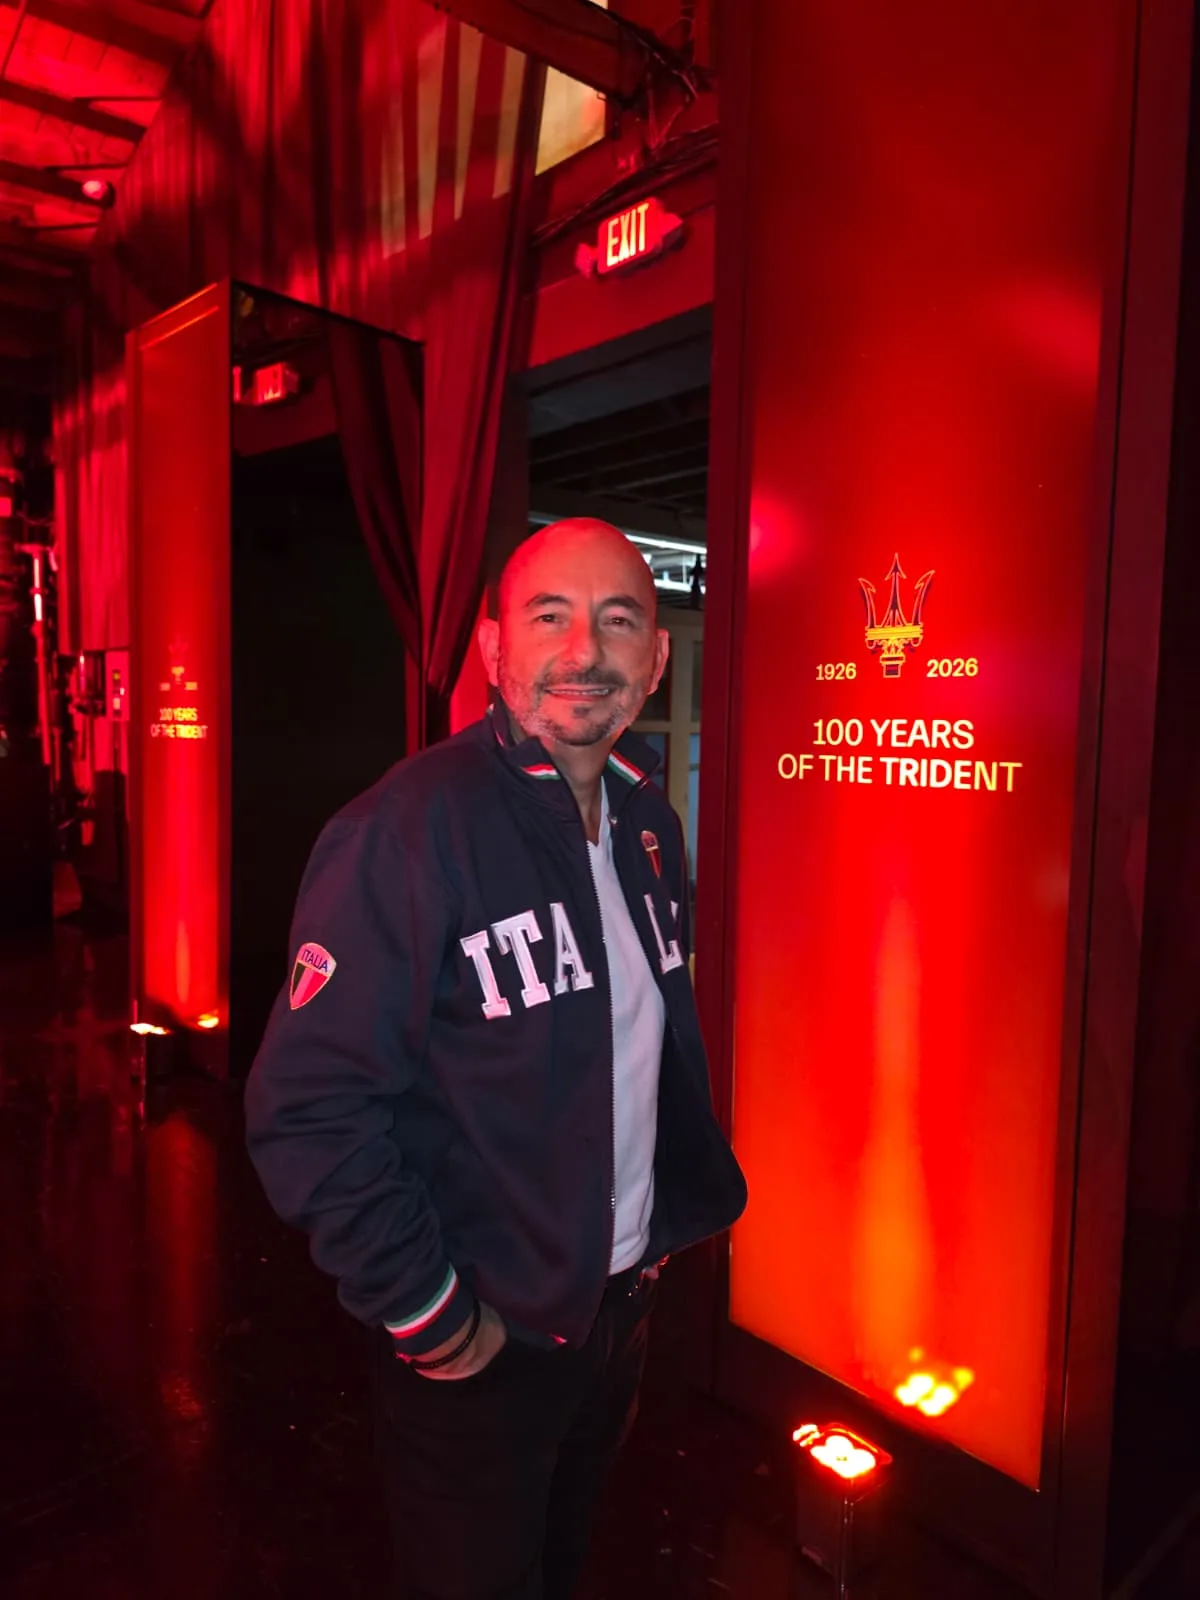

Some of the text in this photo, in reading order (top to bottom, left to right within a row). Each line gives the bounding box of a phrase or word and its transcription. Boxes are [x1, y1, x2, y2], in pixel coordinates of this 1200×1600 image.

[606, 203, 650, 267] EXIT
[815, 658, 979, 681] 1926 2026
[813, 718, 975, 750] 100 YEARS
[777, 753, 1023, 793] OF THE TRIDENT
[301, 948, 329, 973] ITALIA
